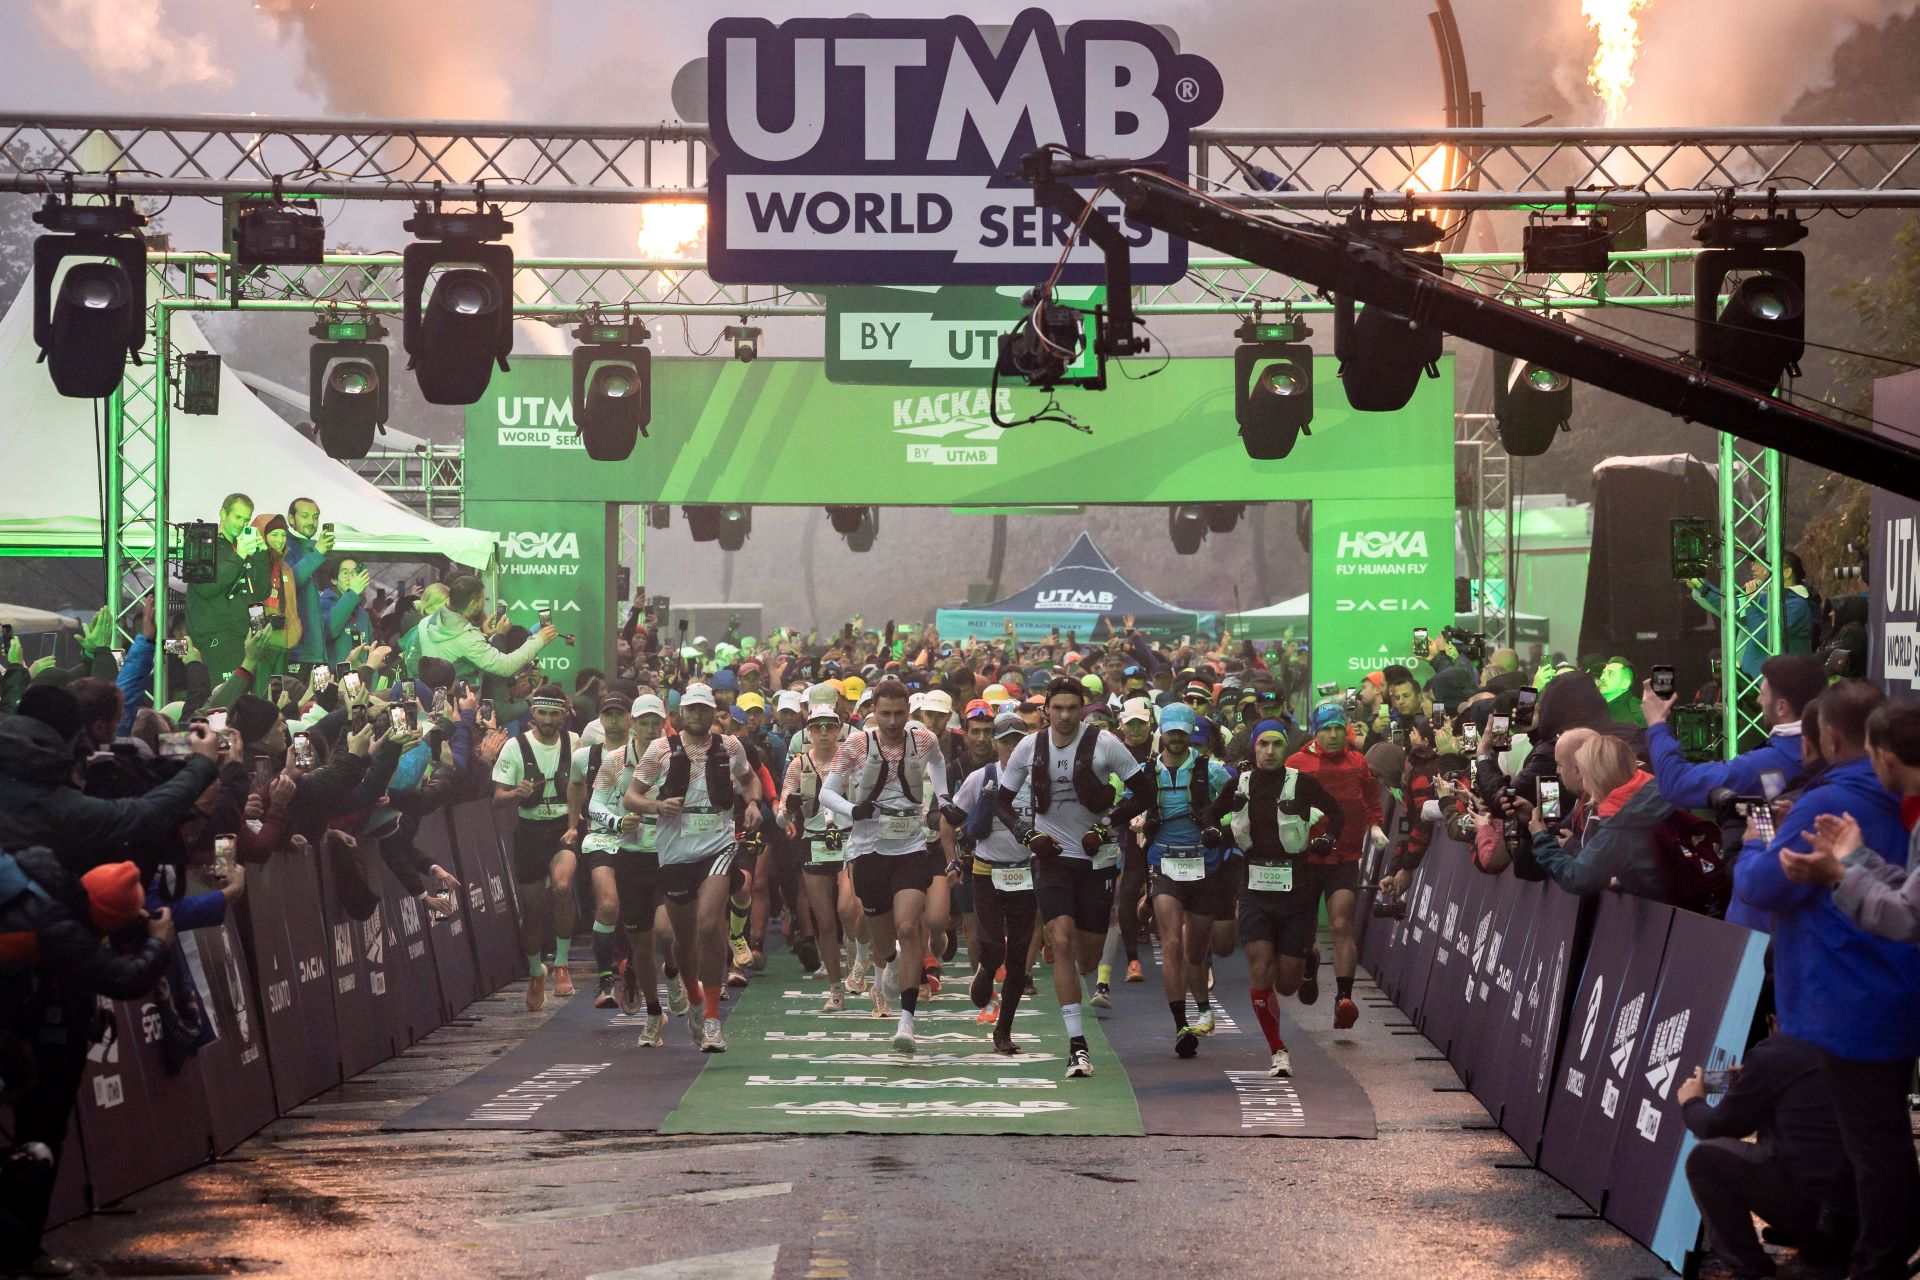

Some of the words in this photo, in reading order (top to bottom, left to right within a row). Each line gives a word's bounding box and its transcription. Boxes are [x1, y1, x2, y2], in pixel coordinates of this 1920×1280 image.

[745, 191, 952, 235] WORLD
[861, 322, 901, 350] BY
[949, 329, 999, 360] UT
[498, 396, 577, 426] UTM
[503, 432, 550, 442] WORLD
[556, 435, 584, 445] SERI
[915, 448, 929, 458] BY
[947, 450, 987, 462] UTMB
[1336, 531, 1428, 558] HOKA
[510, 564, 558, 575] HUMAN
[559, 565, 580, 575] FLY
[1336, 564, 1355, 575] FLY
[1358, 564, 1406, 575] HUMAN
[1407, 563, 1428, 574] FLY
[1037, 589, 1114, 604] UTMB
[497, 599, 581, 611] ACIA
[1336, 599, 1430, 611] DACIA
[990, 621, 1005, 629] YOU
[1887, 635, 1912, 667] WORLD
[1003, 873, 1024, 881] 5006
[1260, 872, 1281, 880] 1020
